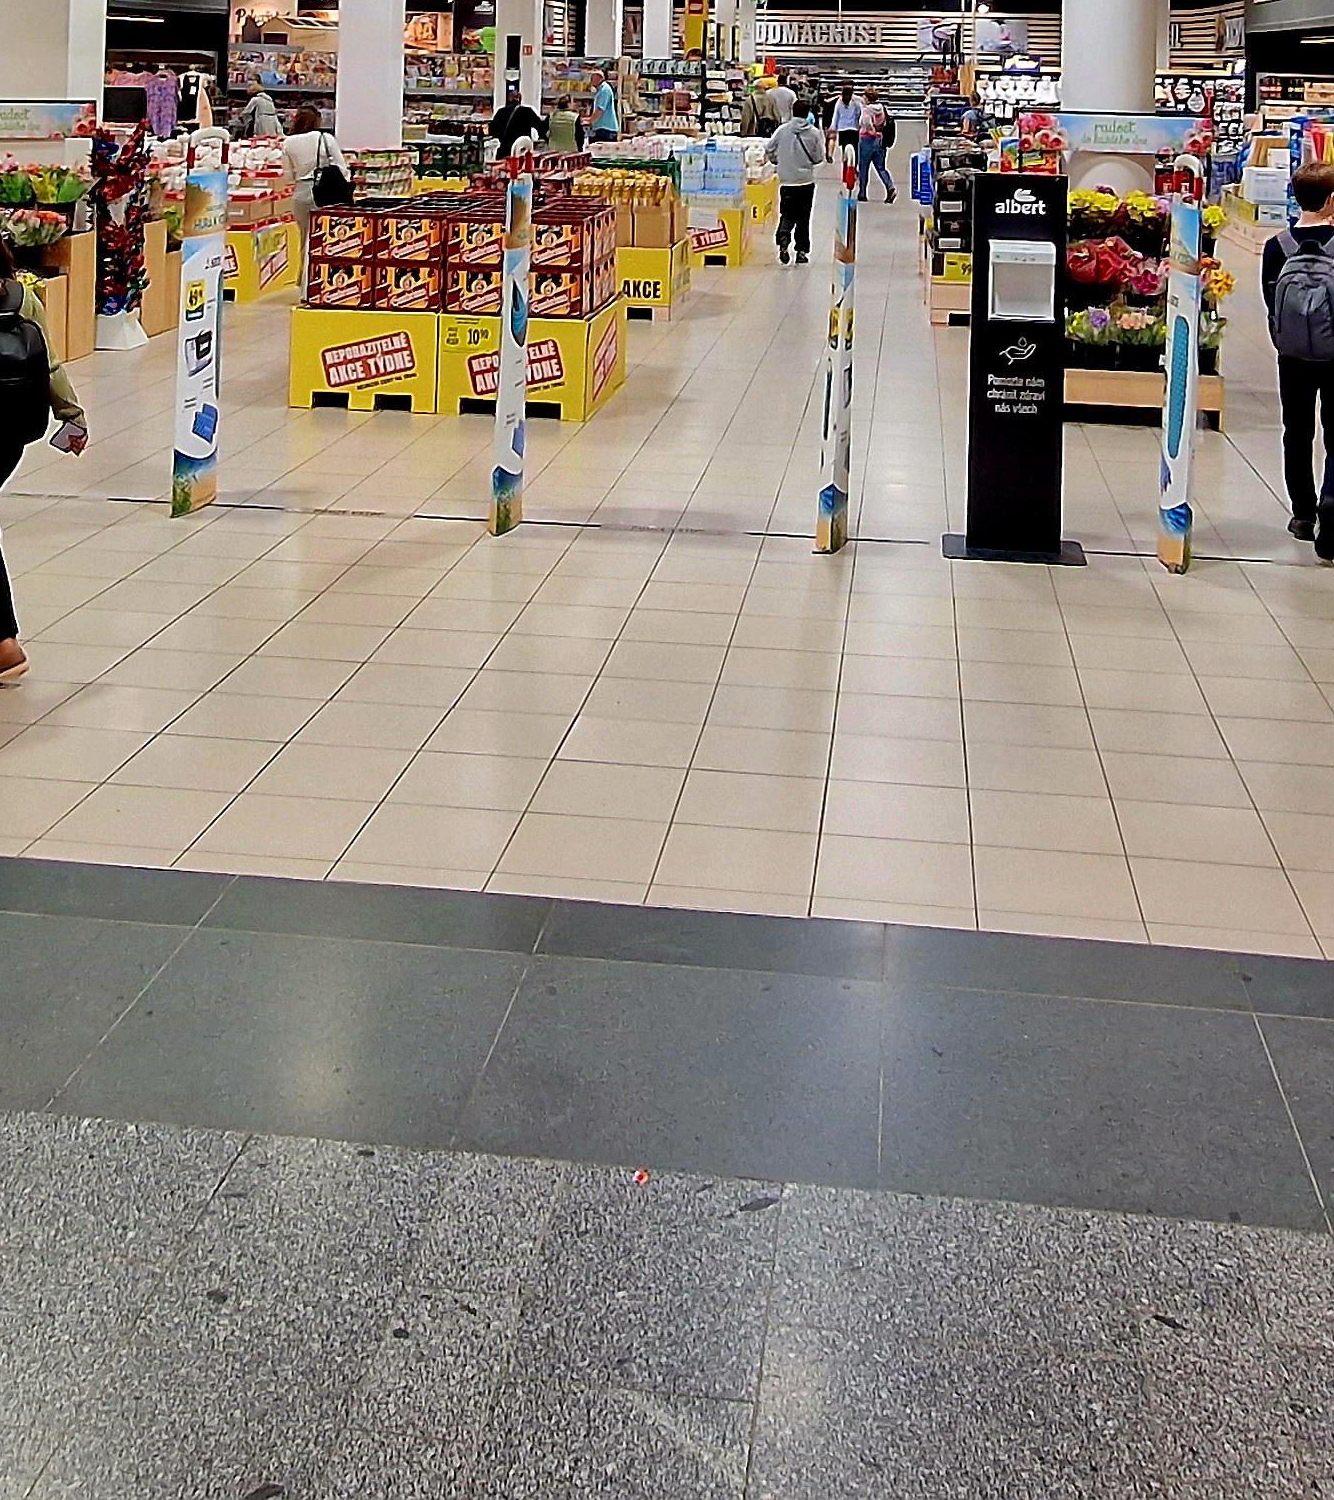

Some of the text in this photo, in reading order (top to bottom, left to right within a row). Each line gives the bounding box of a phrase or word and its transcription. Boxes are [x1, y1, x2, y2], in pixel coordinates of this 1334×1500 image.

[995, 198, 1047, 215] albert
[622, 279, 661, 299] AKCE
[325, 332, 409, 365] NEPORAZITELNÉ
[329, 350, 414, 386] AKCE TÝDNE
